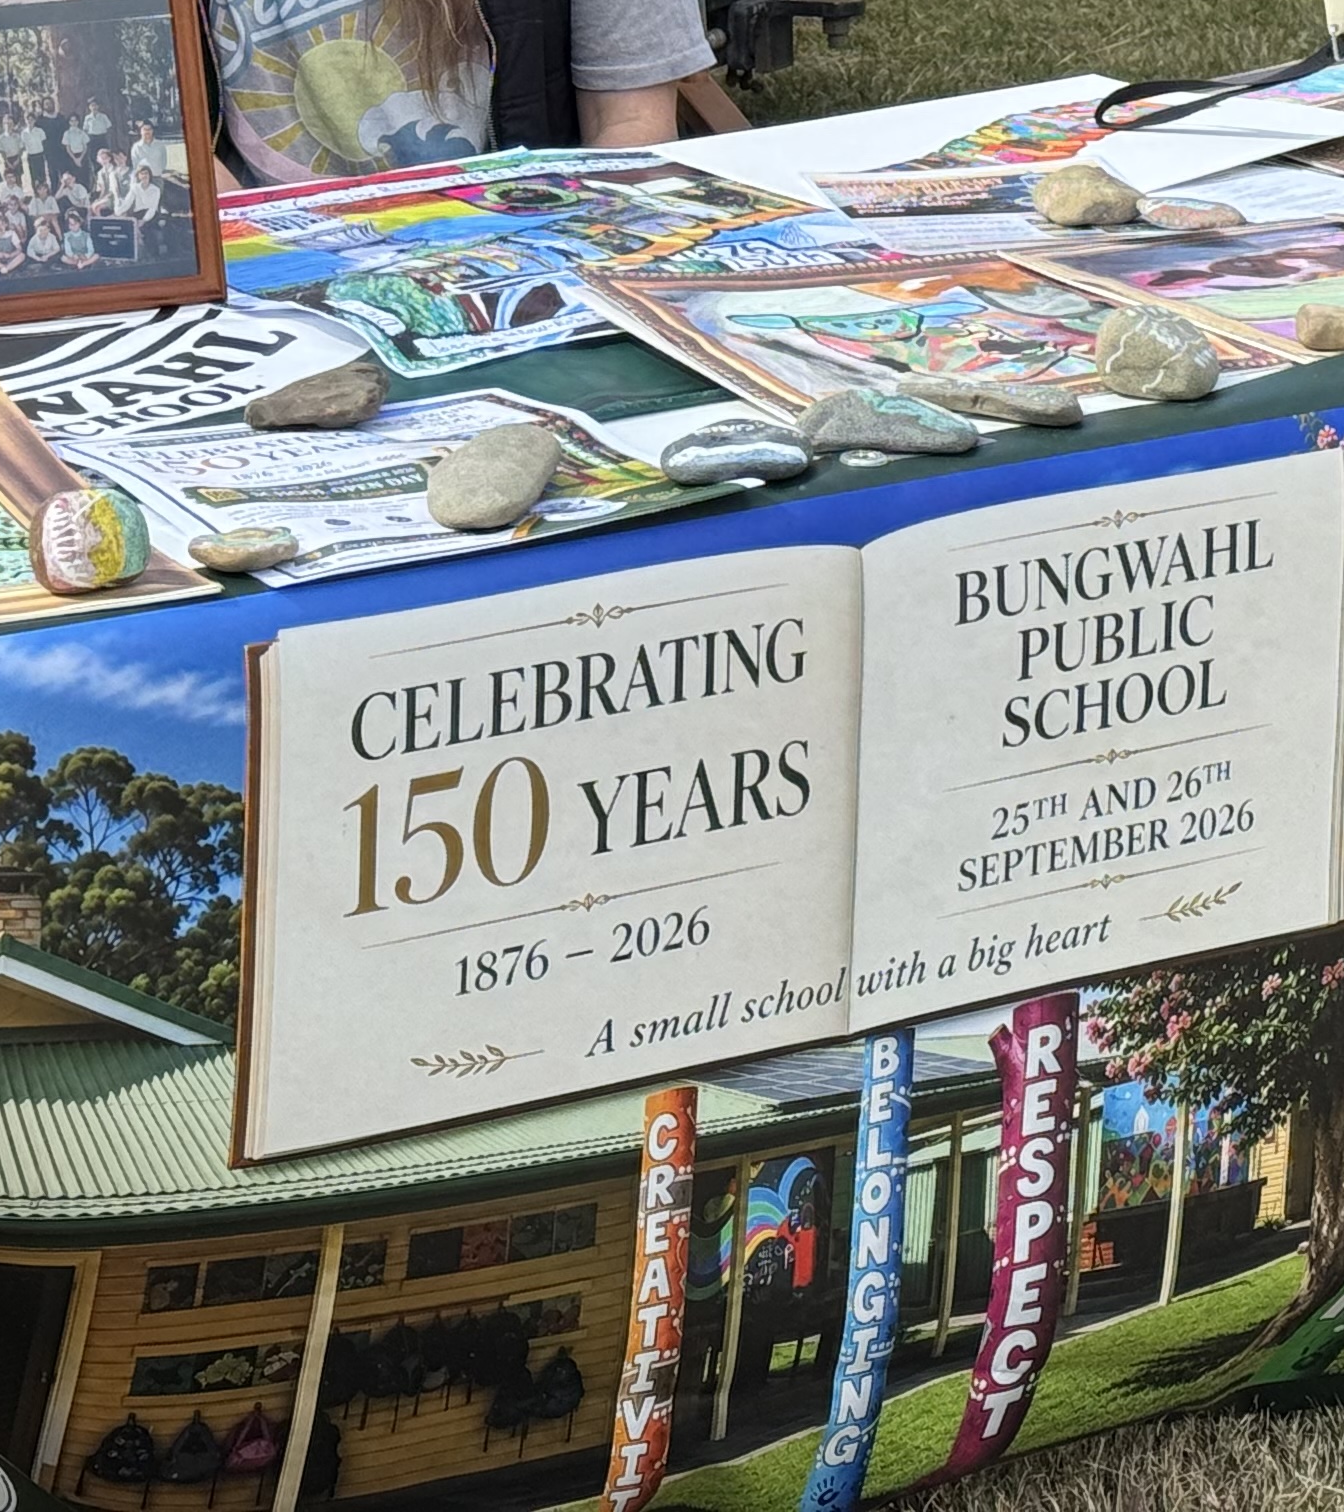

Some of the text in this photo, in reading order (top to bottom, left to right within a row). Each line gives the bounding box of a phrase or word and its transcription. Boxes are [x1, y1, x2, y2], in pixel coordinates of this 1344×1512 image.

[34, 382, 266, 437] CHOOL
[107, 431, 358, 461] CELEBRATING
[136, 454, 251, 476] 150
[256, 436, 385, 462] YEARS
[386, 472, 425, 487] DAY
[953, 518, 1275, 627] BUNGWAHL
[1016, 594, 1216, 682] PUBLIC
[350, 618, 807, 762] CELEBRATING
[1002, 657, 1228, 749] SCHOOL
[342, 739, 812, 919] 150 YEARS
[956, 797, 1256, 893] SEPTEMBER 2026
[990, 760, 1232, 842] 25TH AND 26TH
[454, 938, 550, 997] 1876
[610, 905, 711, 964] 2026
[584, 914, 1112, 1057] A small school with a big heart
[822, 1035, 901, 1469] BELONGING
[979, 1023, 1066, 1441] RESPECT
